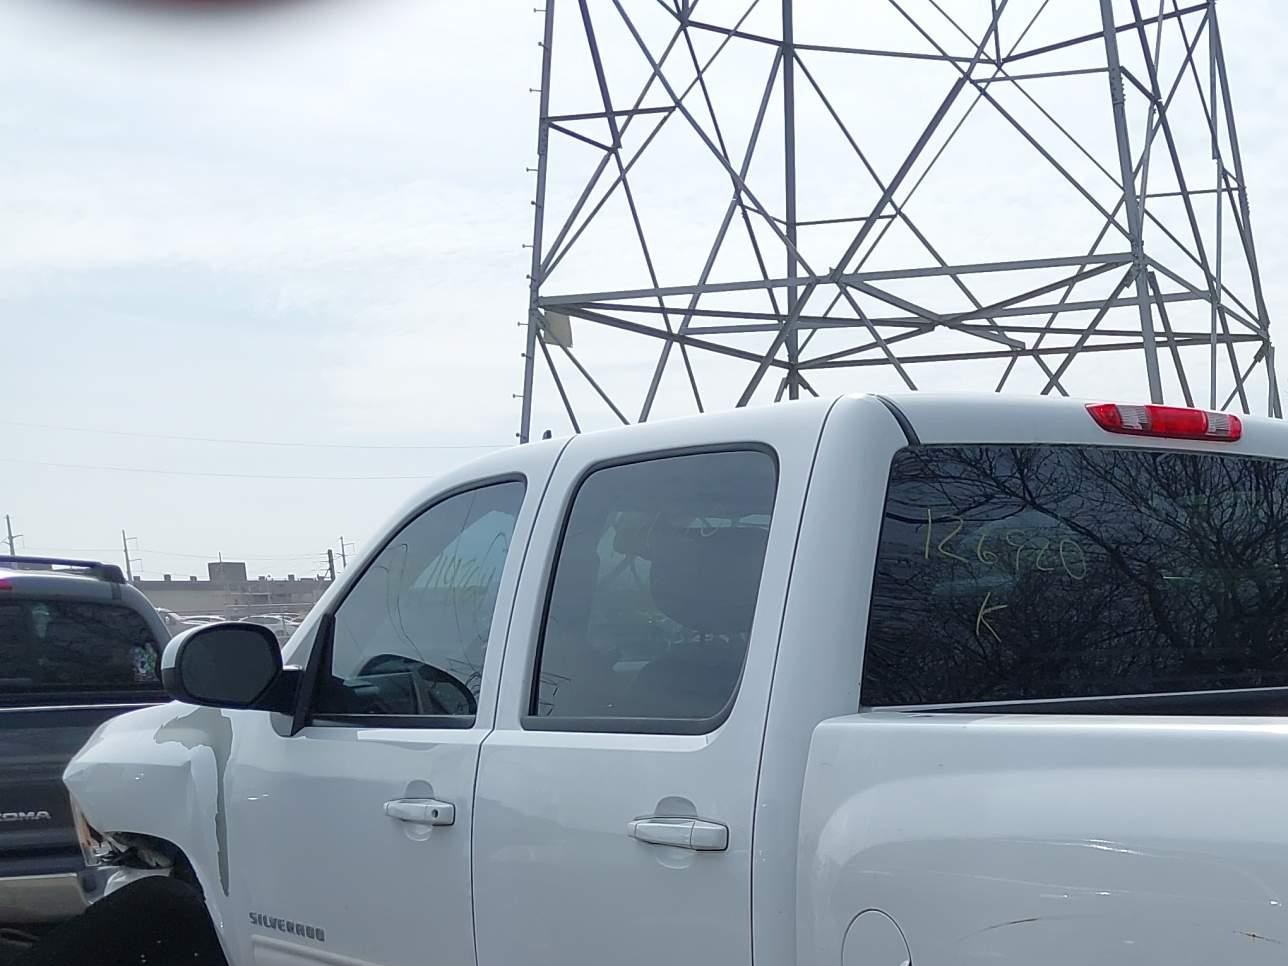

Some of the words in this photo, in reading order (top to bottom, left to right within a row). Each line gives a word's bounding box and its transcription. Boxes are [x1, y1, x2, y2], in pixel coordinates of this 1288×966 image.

[976, 592, 1008, 643] K
[0, 810, 52, 822] OMA
[249, 911, 325, 942] SILVERADO
